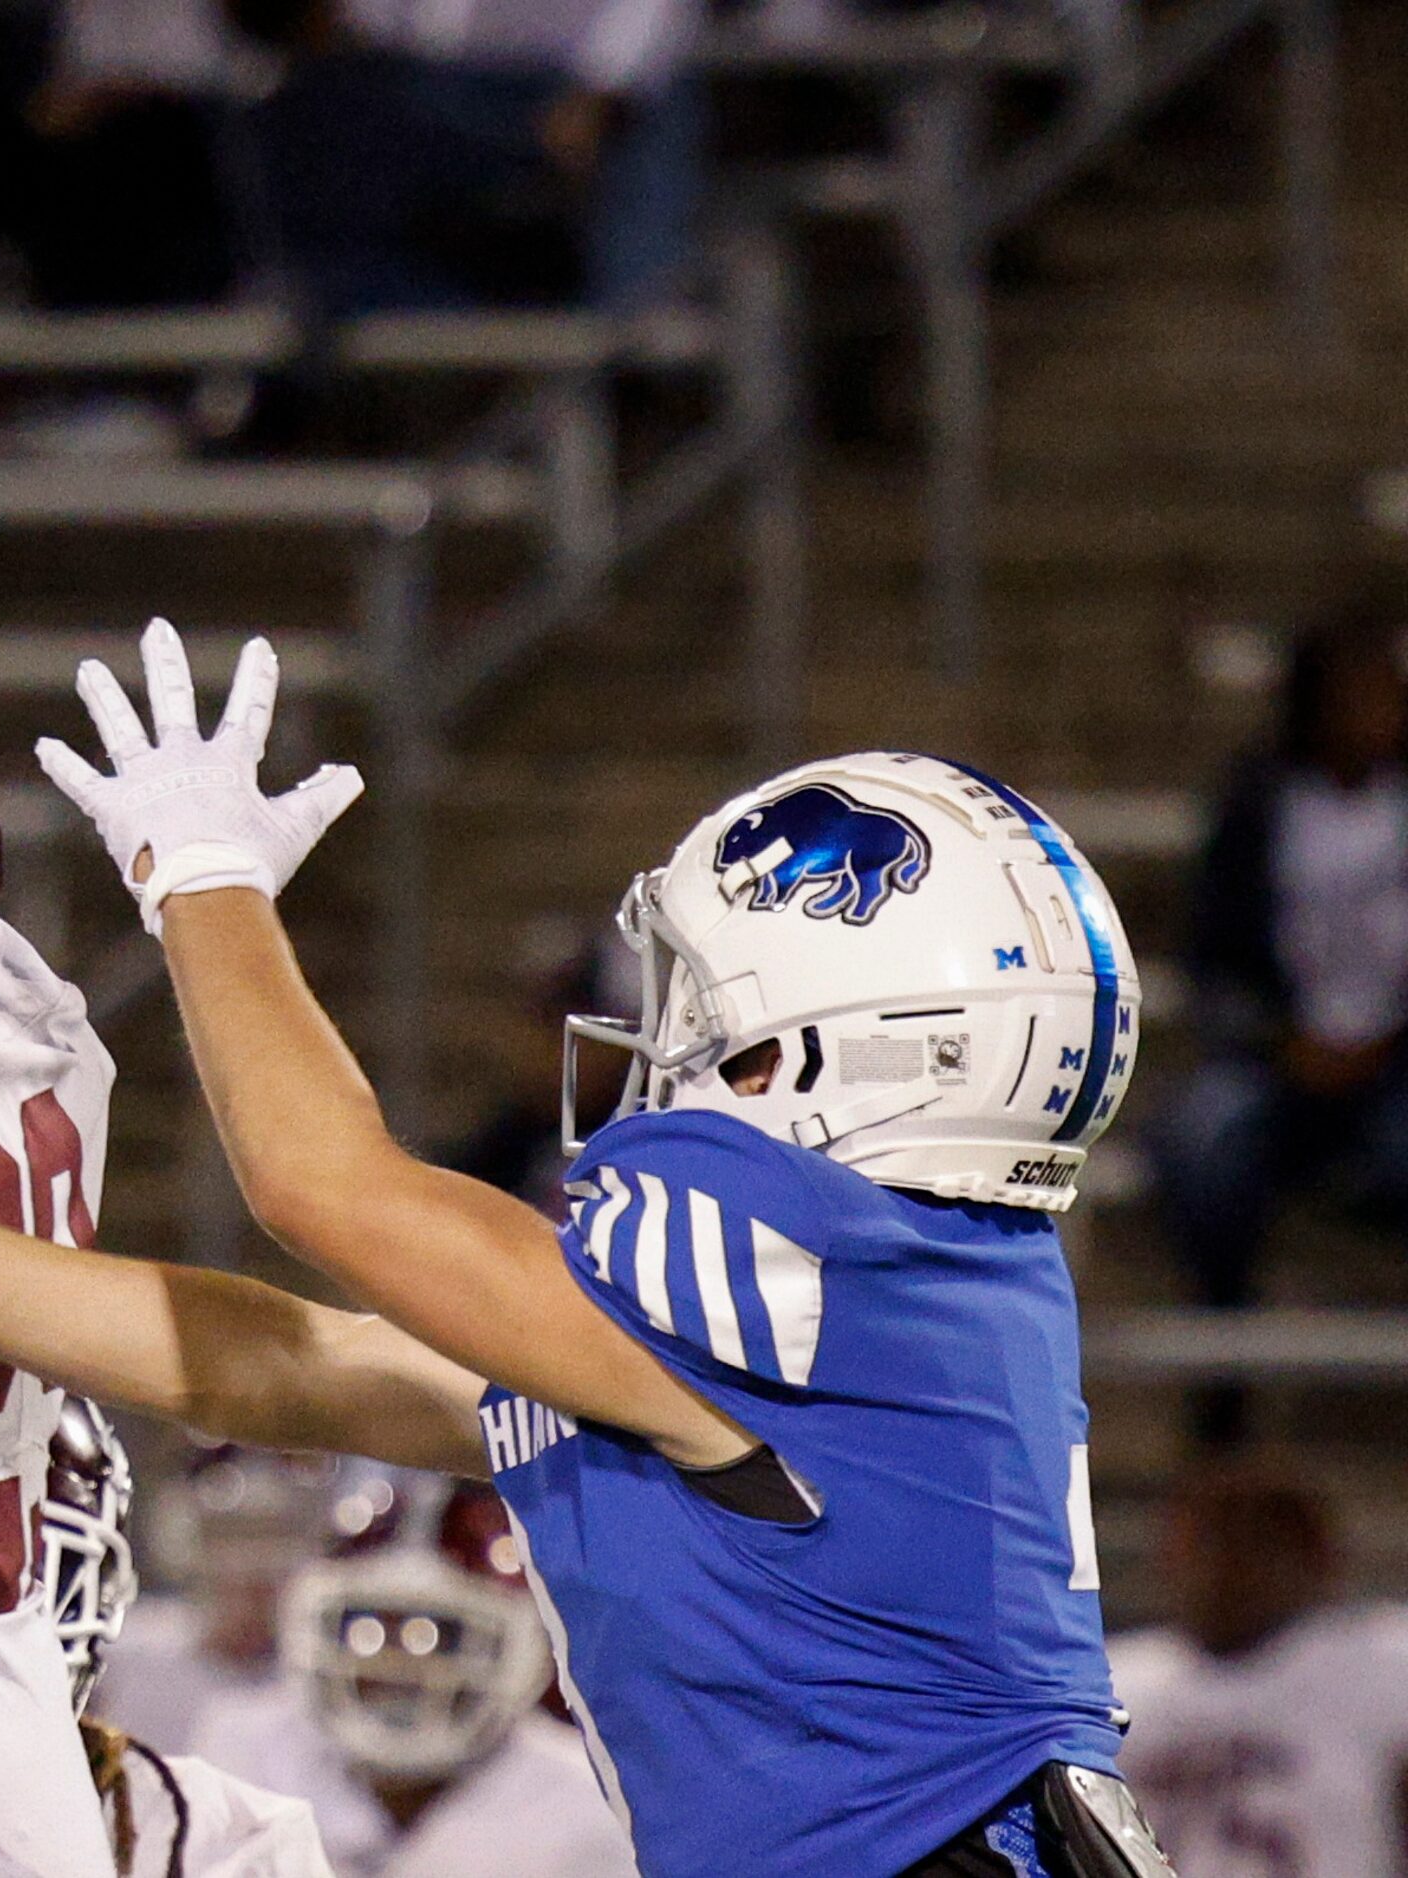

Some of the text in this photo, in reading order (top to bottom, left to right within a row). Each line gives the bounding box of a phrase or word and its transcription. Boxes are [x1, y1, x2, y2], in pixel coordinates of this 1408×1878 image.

[992, 946, 1027, 971] M
[1058, 1047, 1085, 1071] M
[1042, 1086, 1072, 1114] M
[1005, 1153, 1080, 1188] schut
